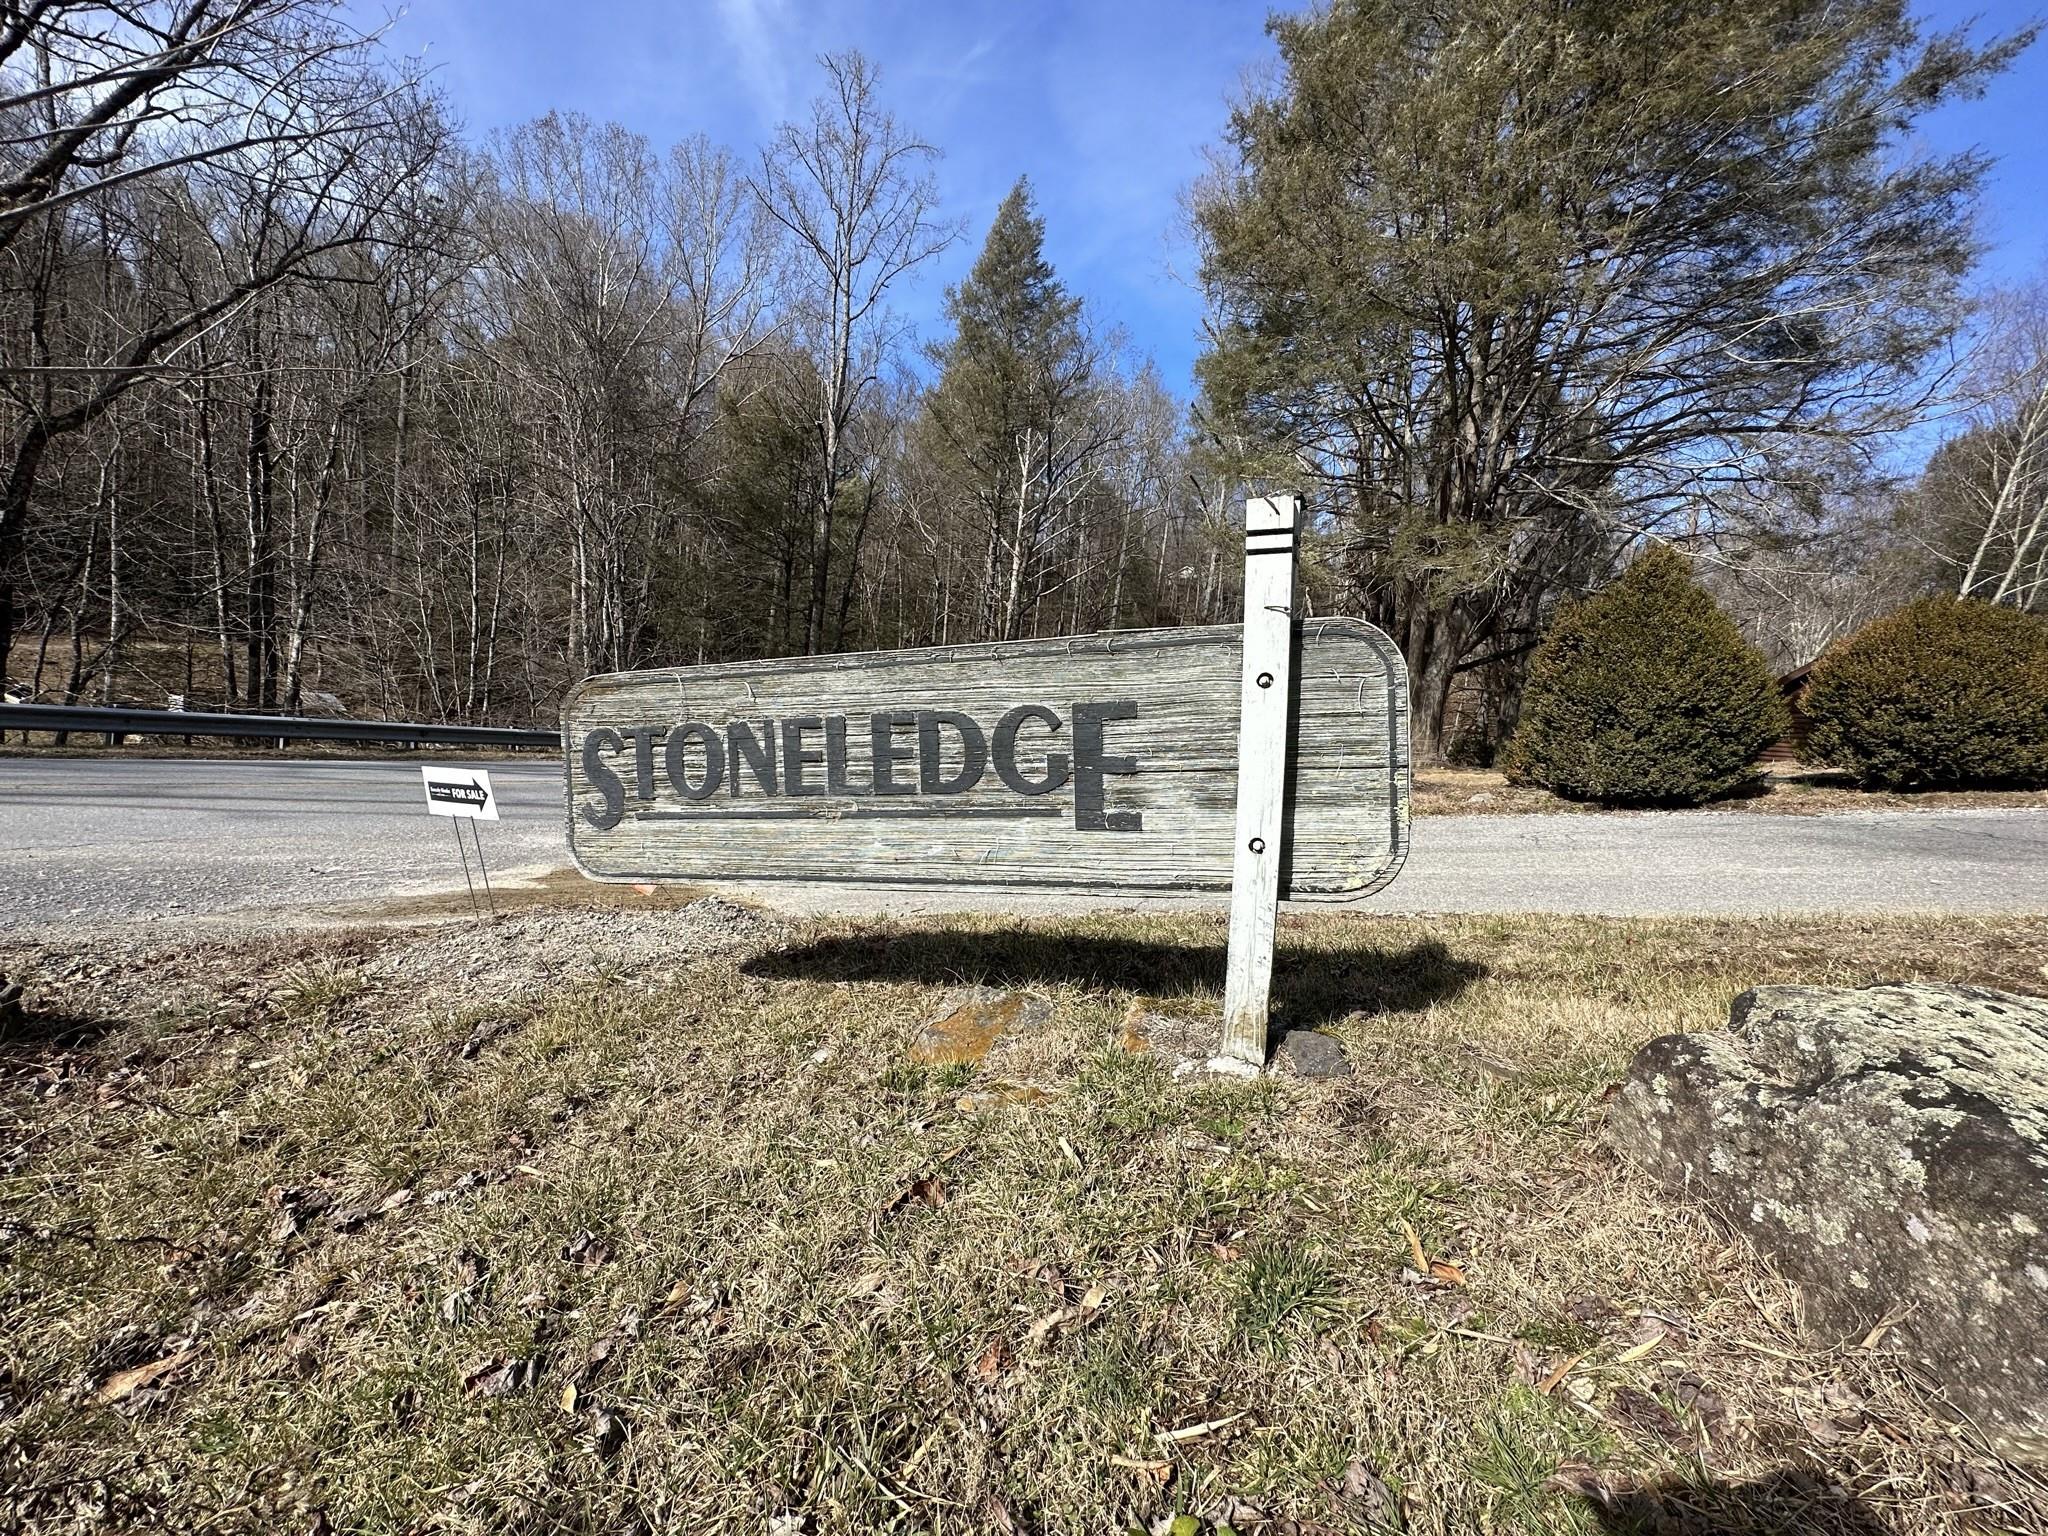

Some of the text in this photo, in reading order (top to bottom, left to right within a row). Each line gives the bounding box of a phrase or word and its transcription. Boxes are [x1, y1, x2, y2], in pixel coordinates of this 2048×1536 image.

[451, 788, 466, 799] FOR
[466, 789, 485, 800] SALE
[582, 700, 1143, 831] STONELEDGE
